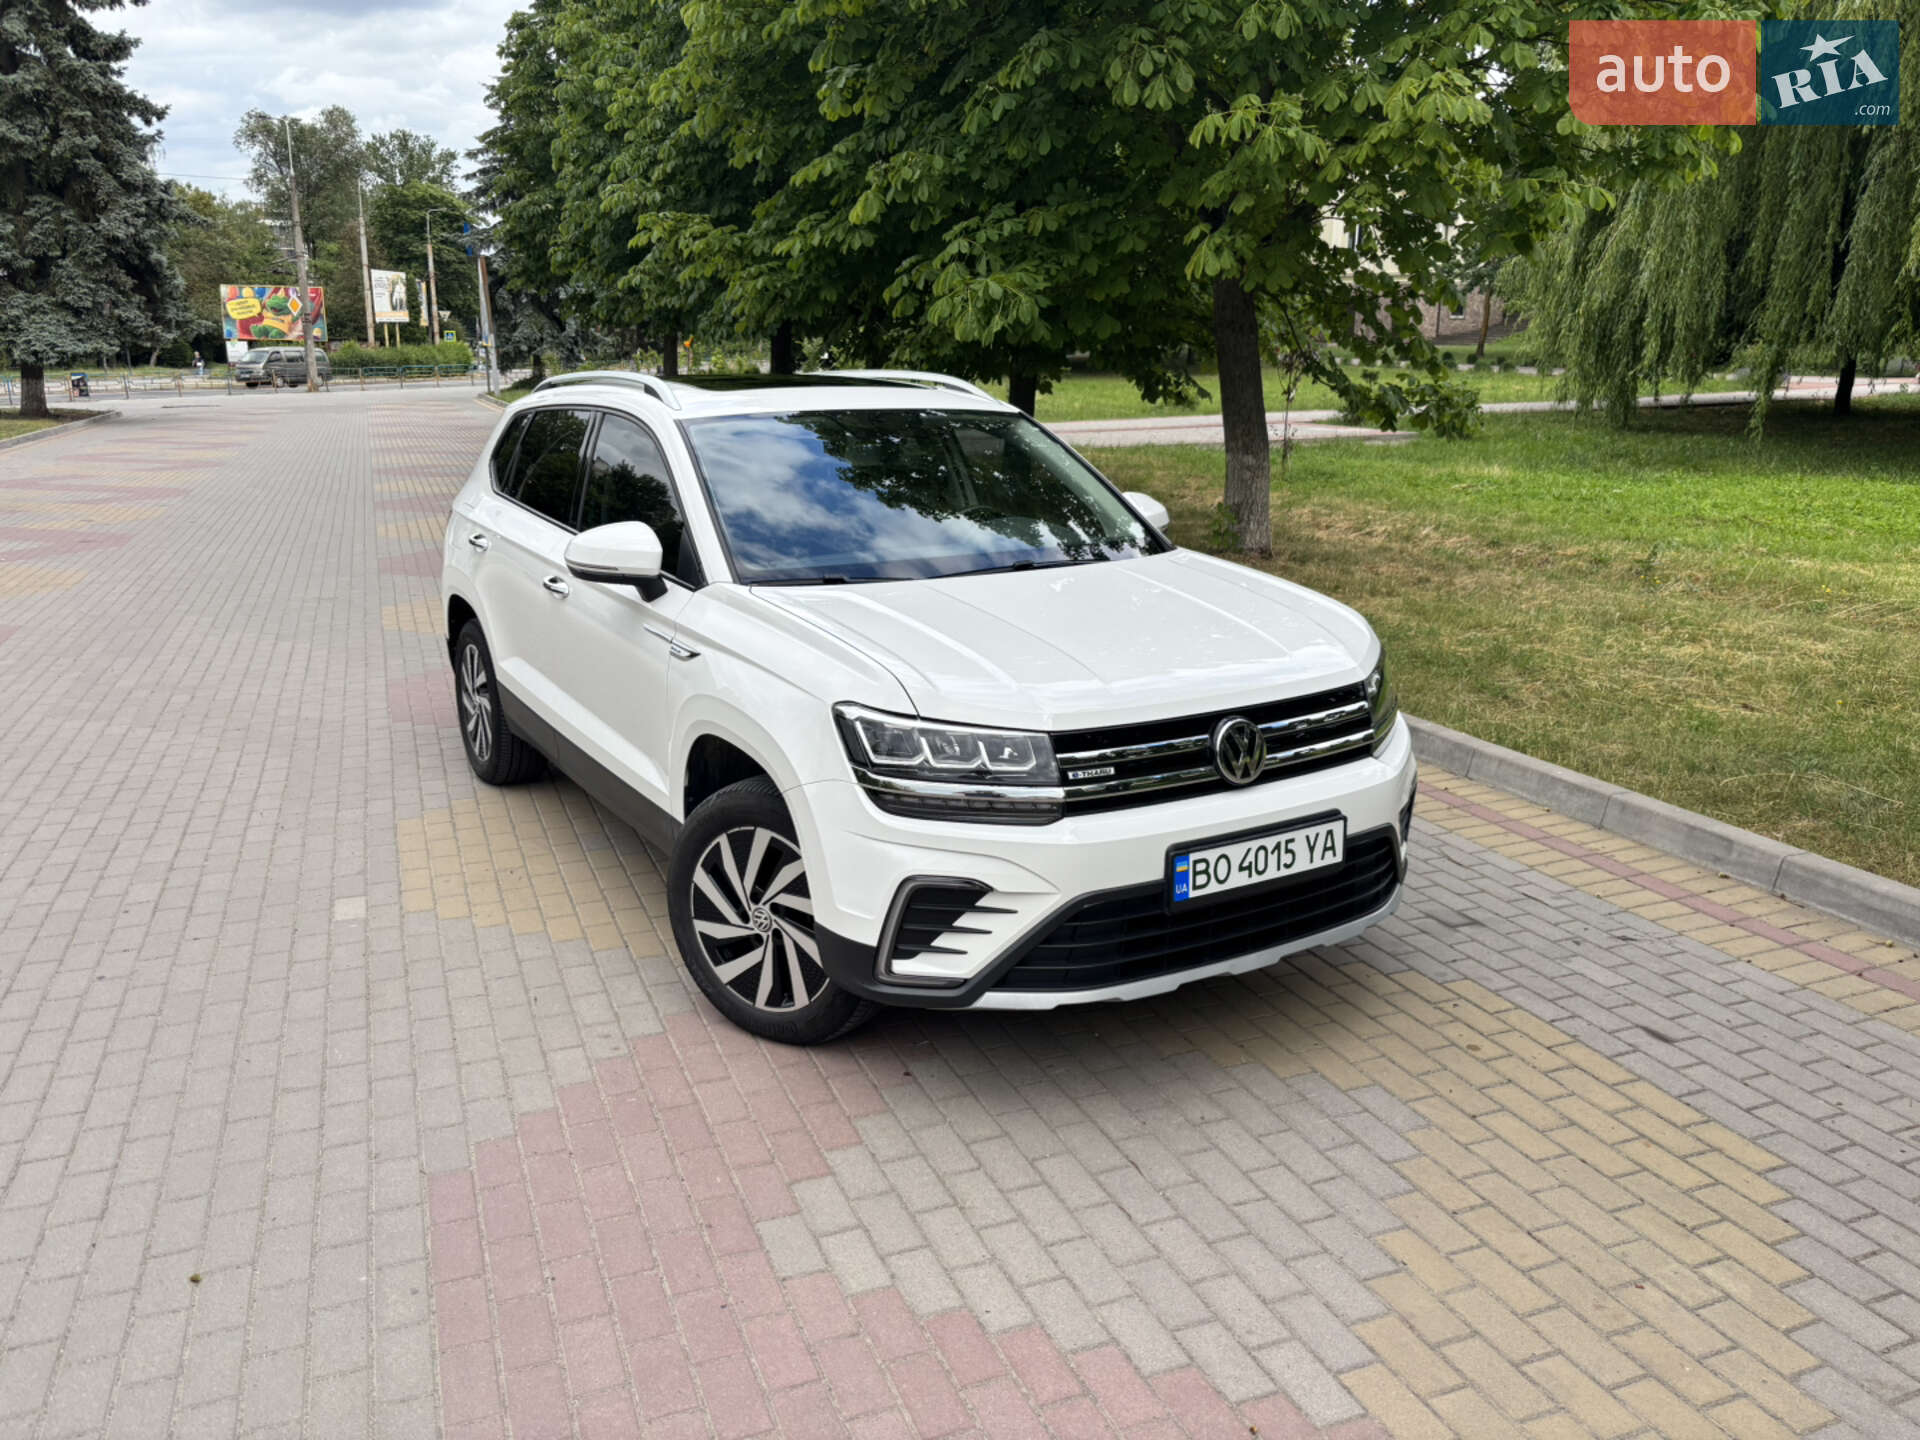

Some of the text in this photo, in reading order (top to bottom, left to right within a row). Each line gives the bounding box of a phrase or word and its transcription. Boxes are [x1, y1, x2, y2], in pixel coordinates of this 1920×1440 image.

[1192, 829, 1337, 891] BO 4015 YA
[1175, 883, 1188, 894] UA
